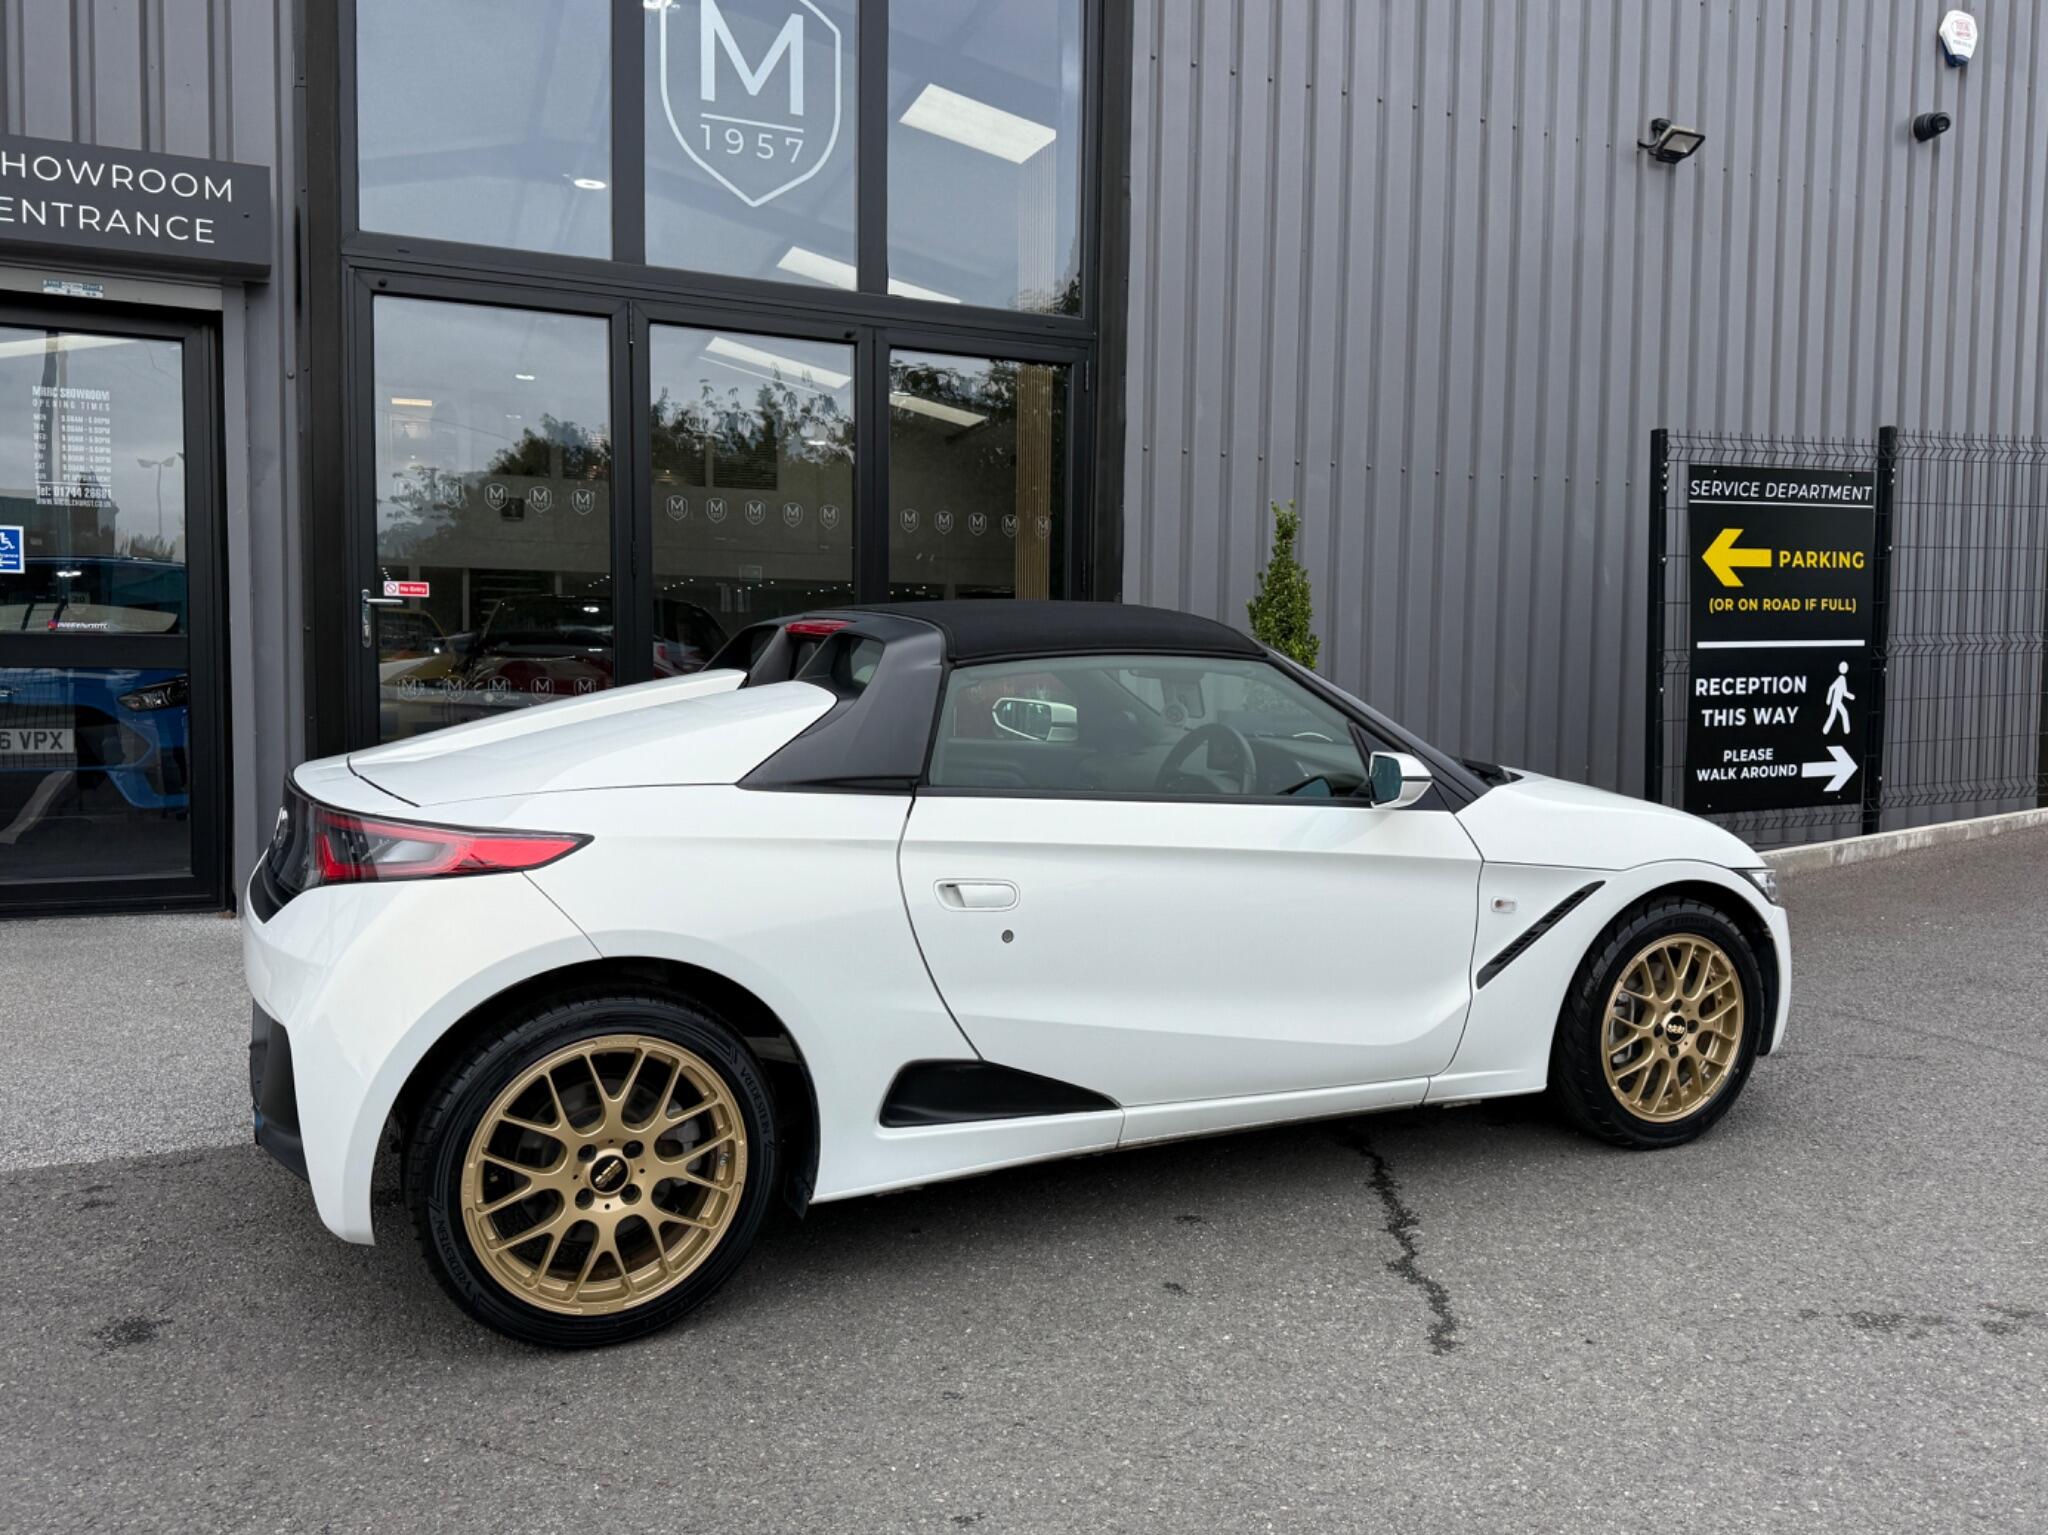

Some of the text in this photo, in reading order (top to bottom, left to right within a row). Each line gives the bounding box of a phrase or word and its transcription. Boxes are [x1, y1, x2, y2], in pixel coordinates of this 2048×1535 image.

[700, 0, 804, 116] M
[700, 123, 804, 164] 1957
[1, 150, 232, 203] HOWROOM
[0, 196, 215, 244] ENTRANCE
[489, 487, 503, 499] M
[533, 489, 548, 501] M
[576, 492, 590, 504] M
[1690, 479, 1873, 501] SERVICE DEPARTMENT
[1779, 550, 1865, 570] PARKING
[1708, 597, 1857, 614] (OR ON ROAD IF FULL)
[536, 679, 550, 692] M
[1695, 675, 1807, 697] RECEPTION
[1701, 706, 1799, 728] THIS WAY
[19, 731, 63, 750] VPX
[1723, 748, 1774, 763] PLEASE
[1696, 764, 1798, 782] WALK AROUND
